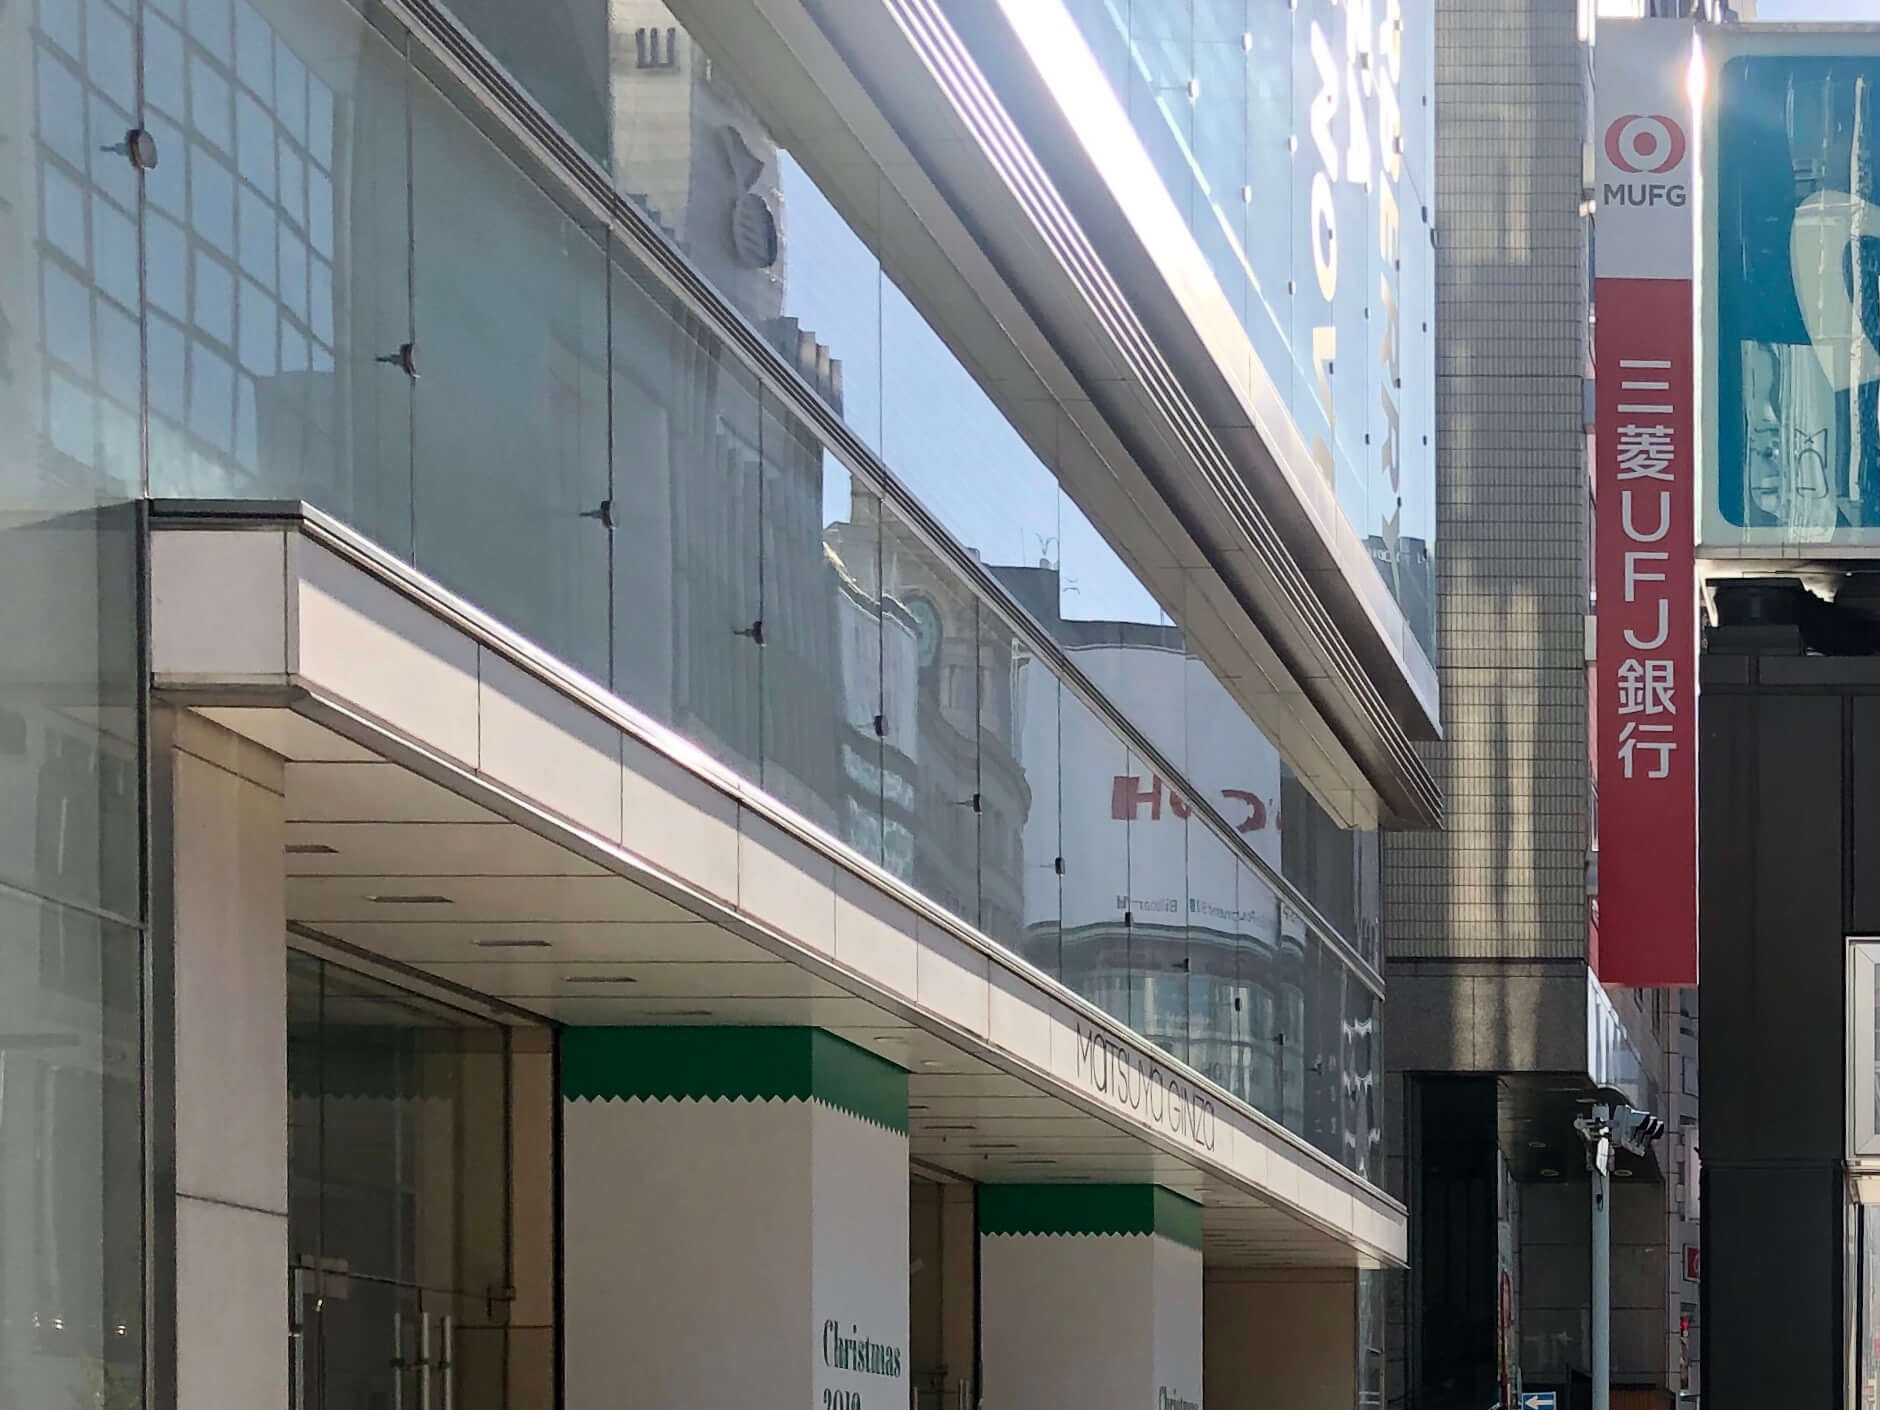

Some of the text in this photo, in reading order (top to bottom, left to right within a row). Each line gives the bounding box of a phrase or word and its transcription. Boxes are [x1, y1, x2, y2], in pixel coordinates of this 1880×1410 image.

[1603, 183, 1687, 207] MUFG
[1616, 359, 1678, 779] 三菱UFJ銀行
[823, 1319, 901, 1378] Christmas
